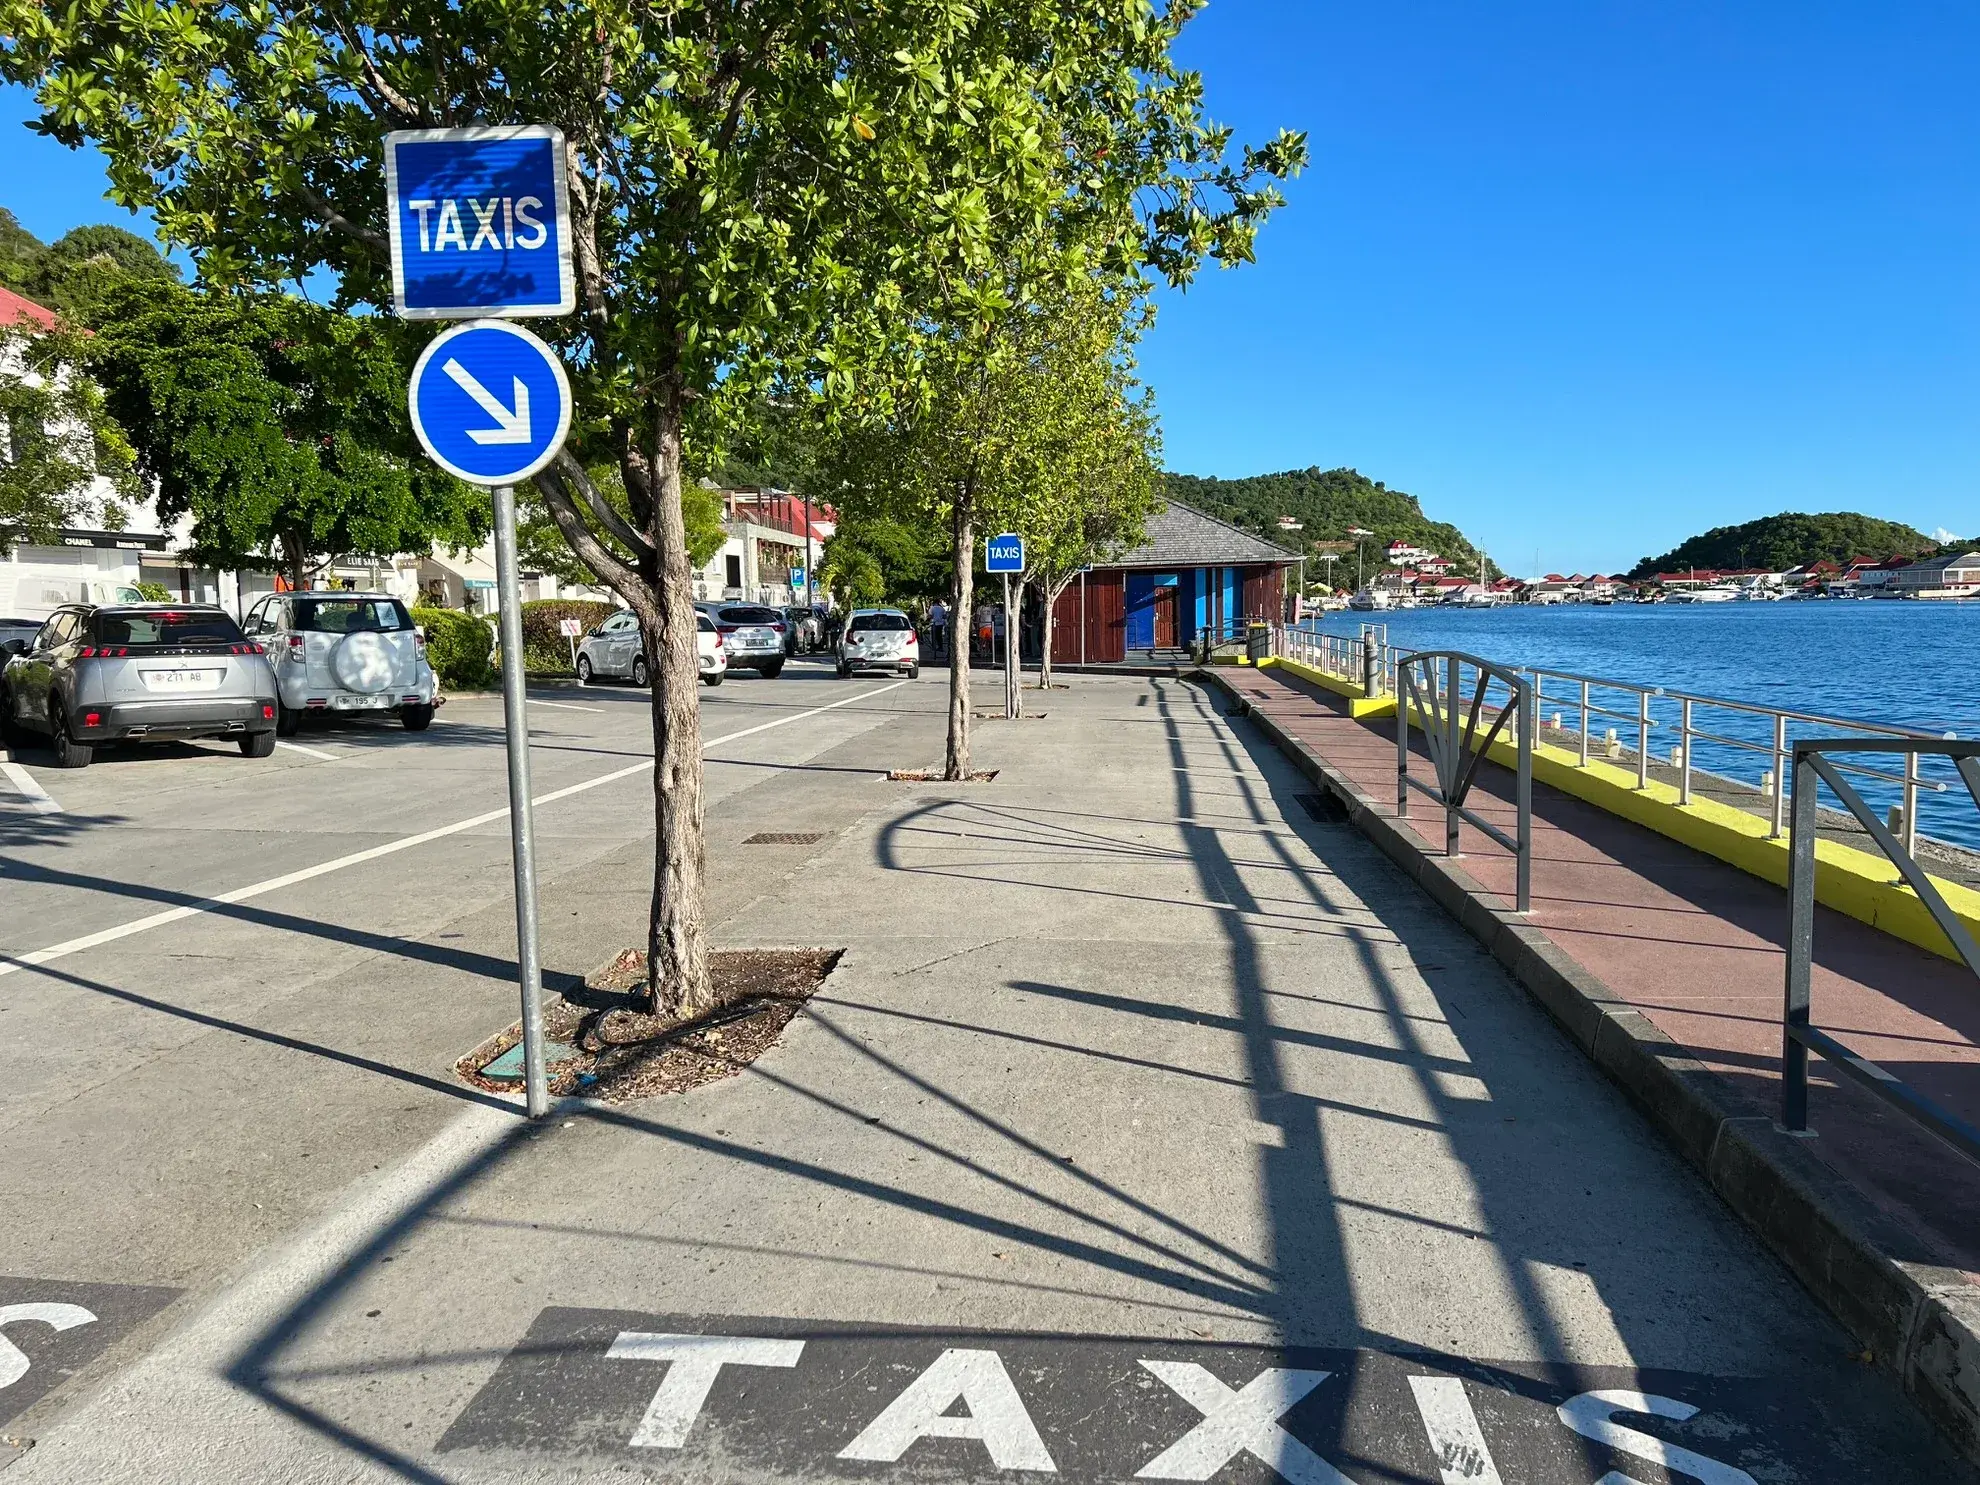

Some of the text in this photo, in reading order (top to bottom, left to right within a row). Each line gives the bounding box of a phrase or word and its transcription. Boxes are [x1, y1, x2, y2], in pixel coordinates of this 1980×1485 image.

[408, 196, 547, 252] TAXIS
[65, 537, 94, 547] CHANEL
[989, 546, 1020, 559] TAXIS
[347, 557, 361, 566] ELIE
[794, 570, 802, 580] P
[167, 673, 183, 682] 271
[355, 696, 369, 705] 195
[604, 1331, 1759, 1485] TAXIS
